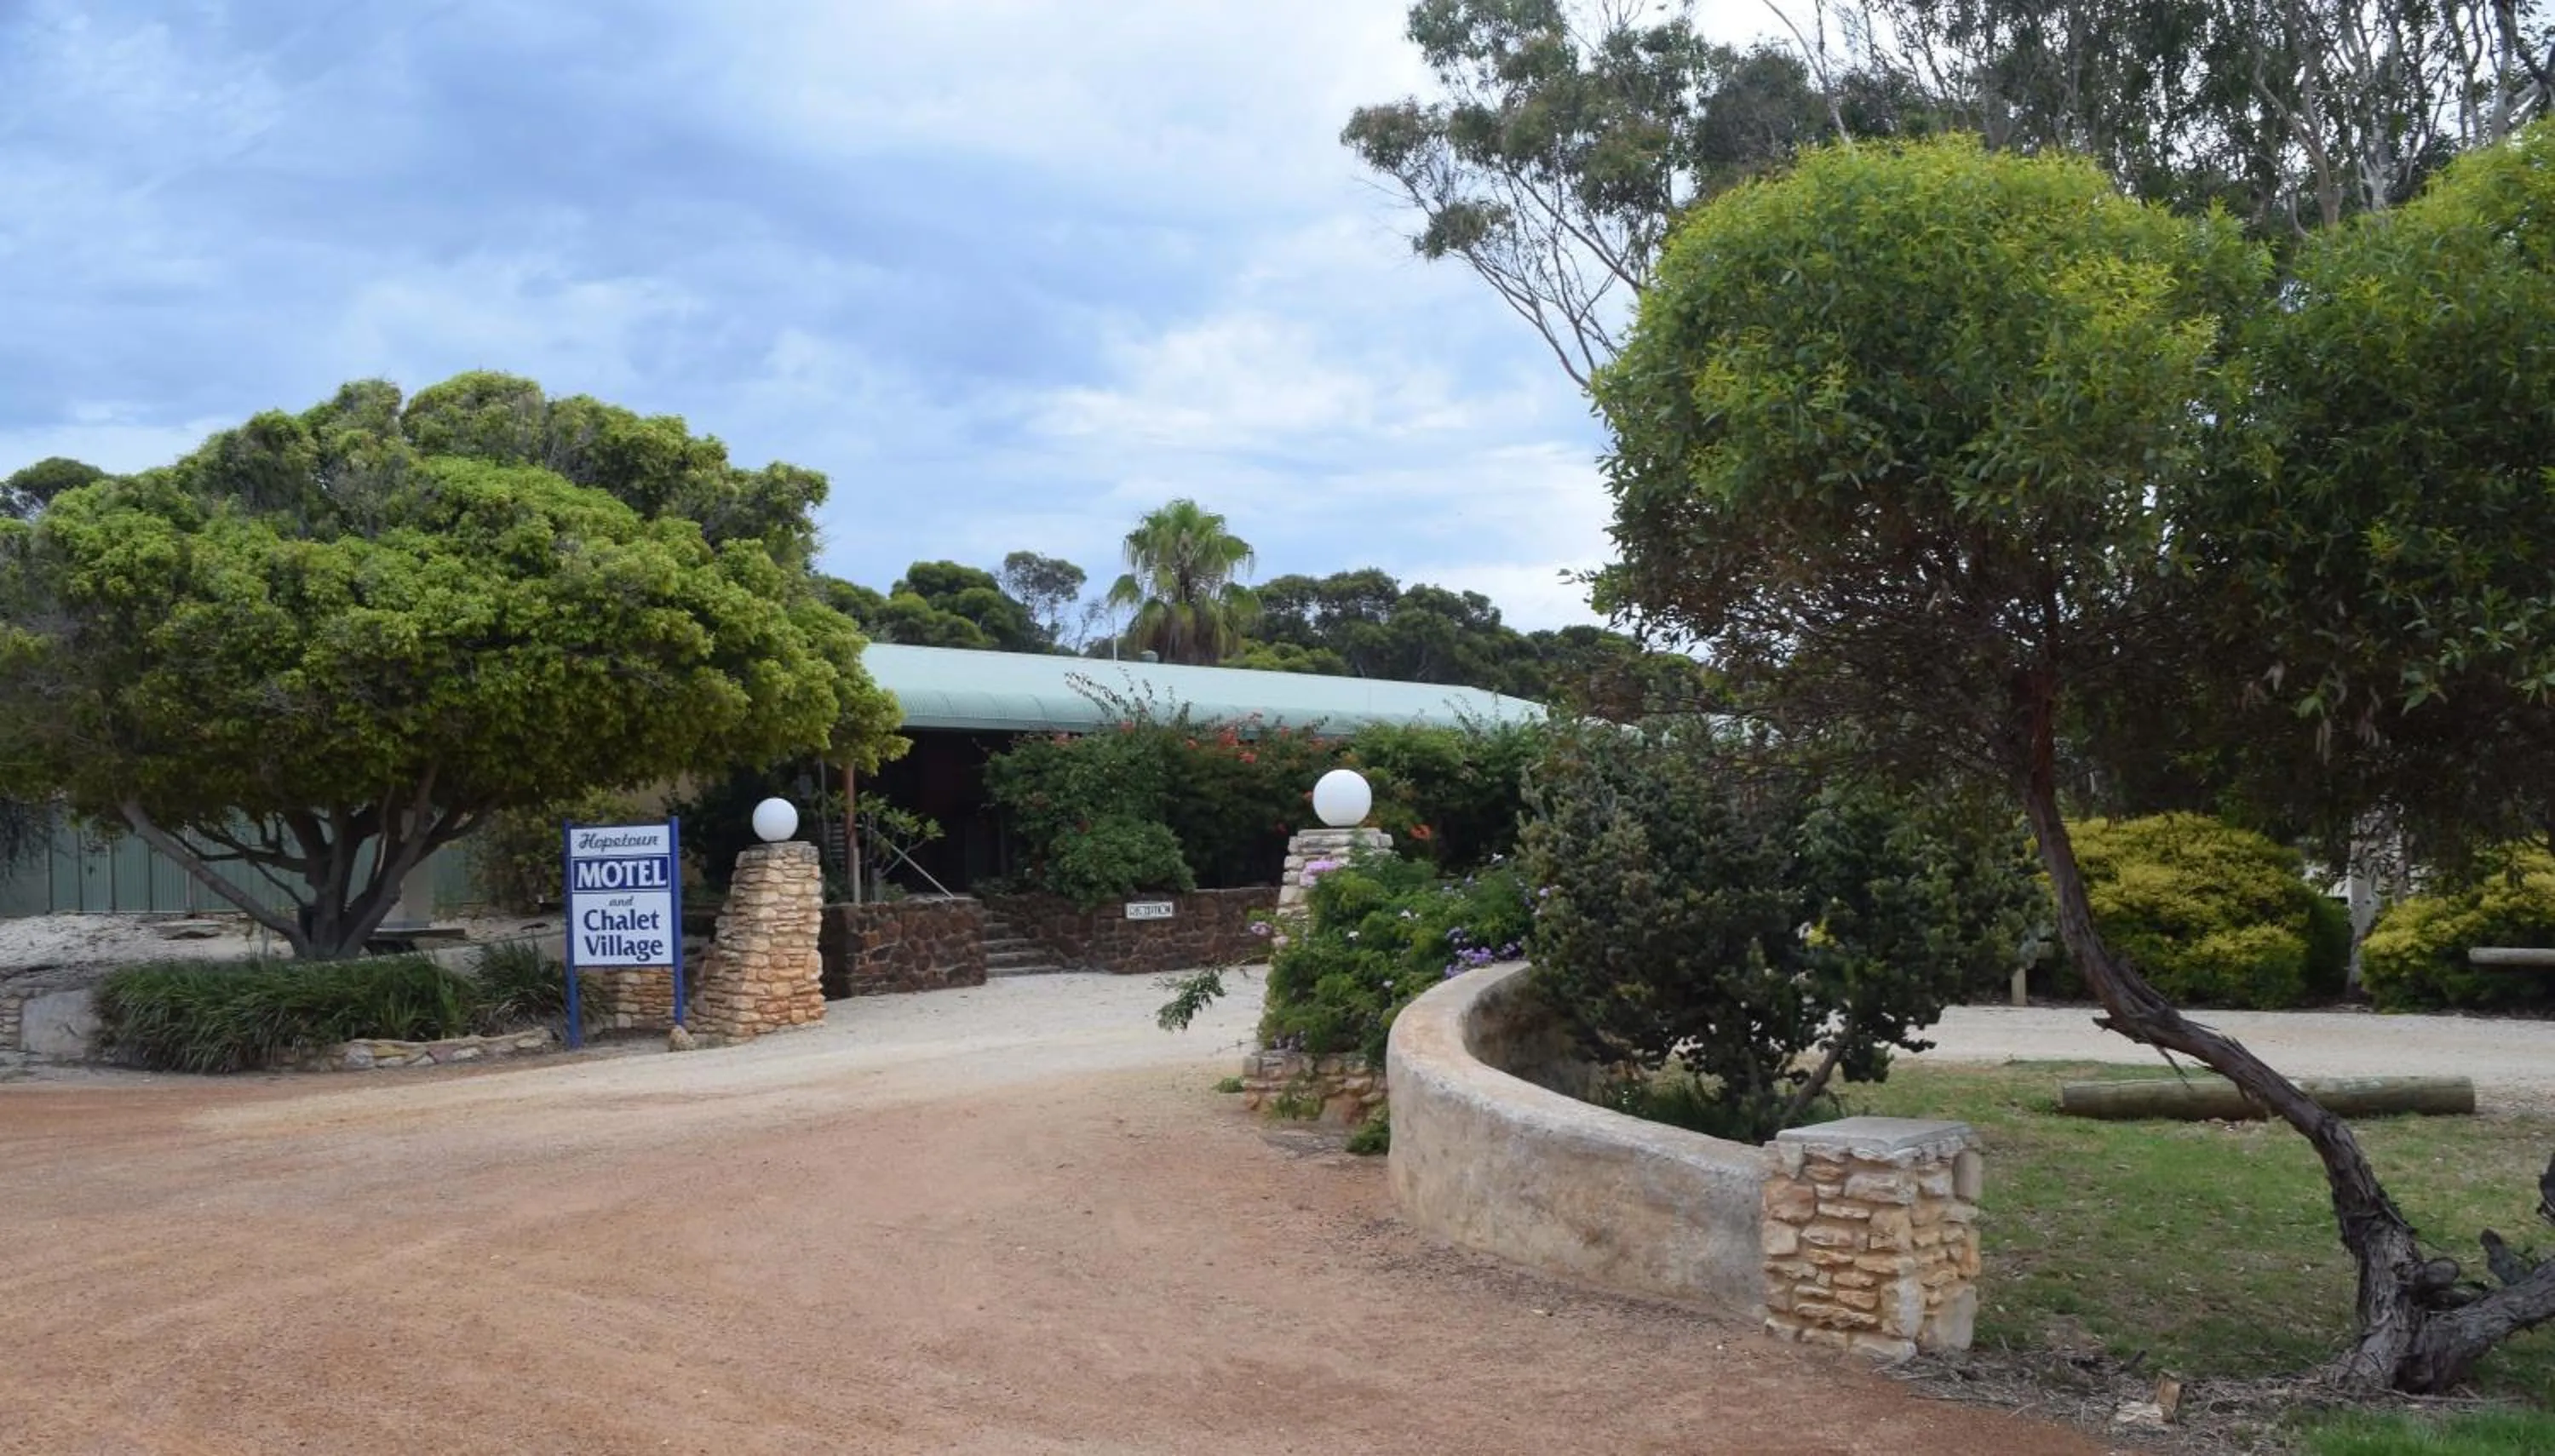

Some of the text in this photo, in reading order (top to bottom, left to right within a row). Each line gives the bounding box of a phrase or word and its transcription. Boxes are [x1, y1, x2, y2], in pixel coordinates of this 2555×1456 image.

[578, 833, 658, 851] Hopetoun
[577, 859, 667, 888] MOTEL
[609, 895, 634, 907] and
[583, 909, 660, 931] Chalet
[584, 934, 663, 962] Village
